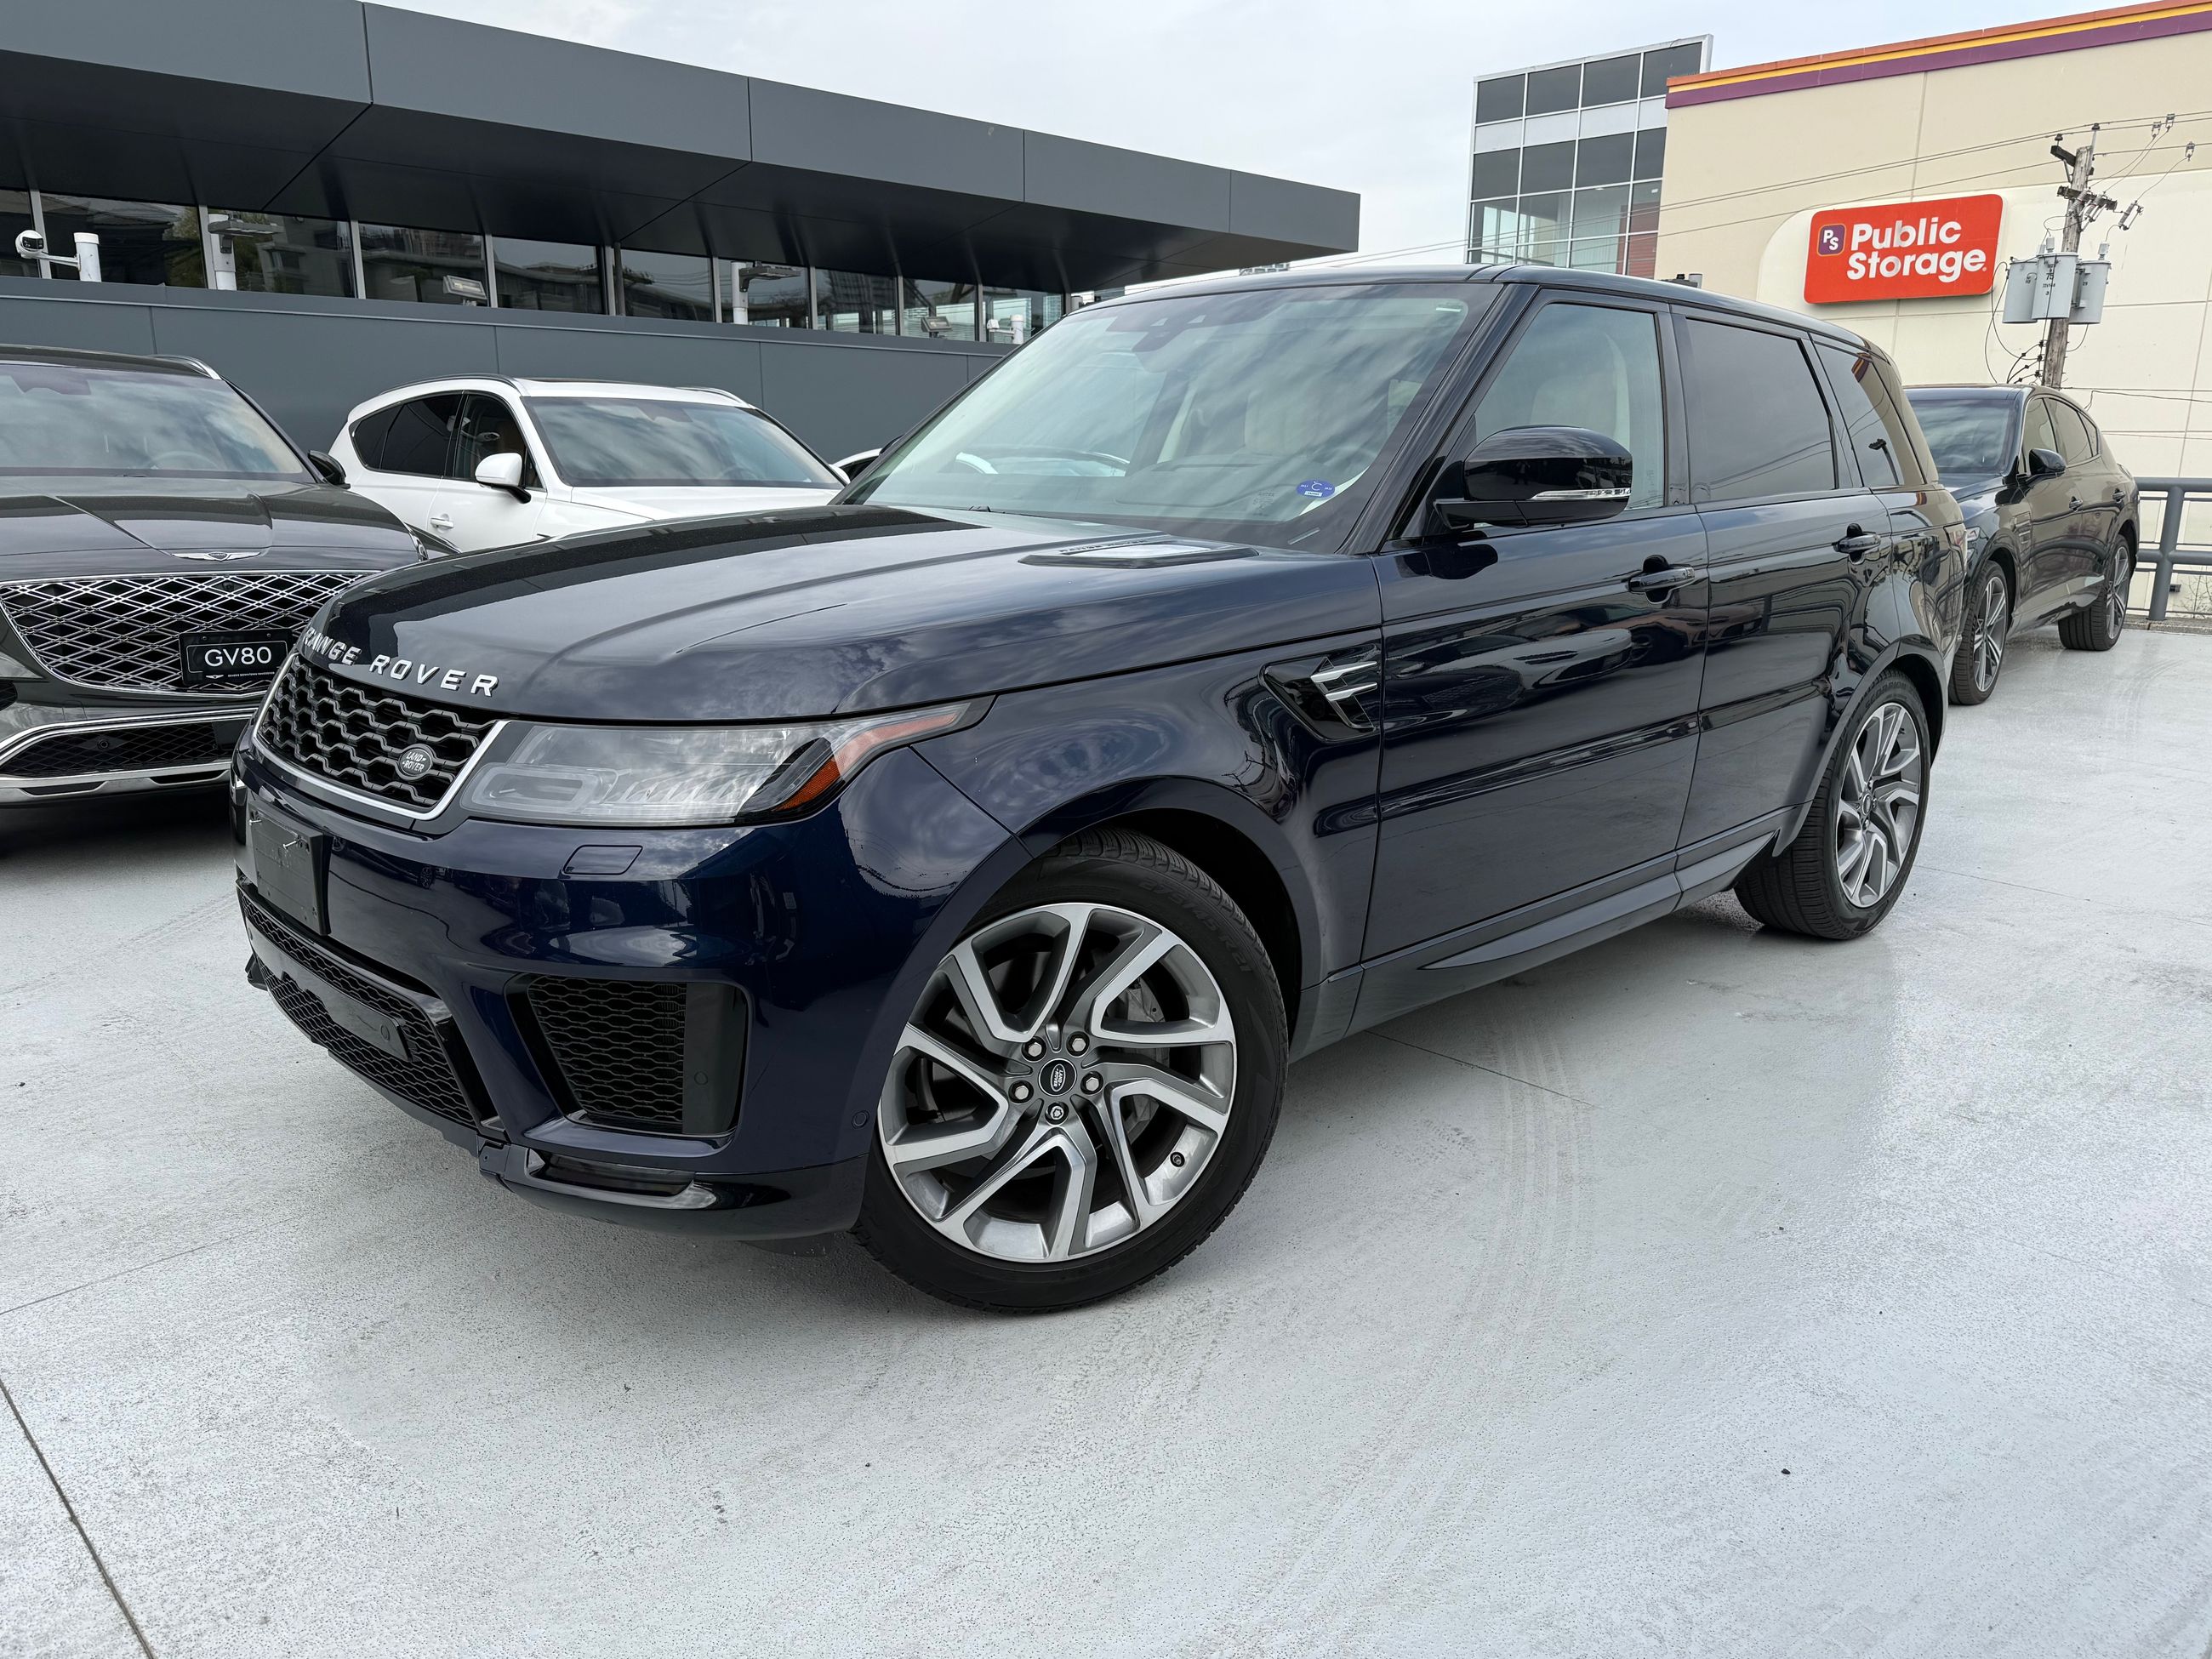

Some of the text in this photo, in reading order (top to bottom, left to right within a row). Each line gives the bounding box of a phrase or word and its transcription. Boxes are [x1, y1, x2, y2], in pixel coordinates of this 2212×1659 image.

[1822, 229, 1839, 251] PS
[1850, 216, 1962, 251] Public
[1846, 248, 1987, 283] Storage
[204, 646, 272, 667] GV80
[302, 626, 499, 698] RANGE ROVER
[403, 760, 425, 772] ROVER
[406, 751, 424, 762] LAND
